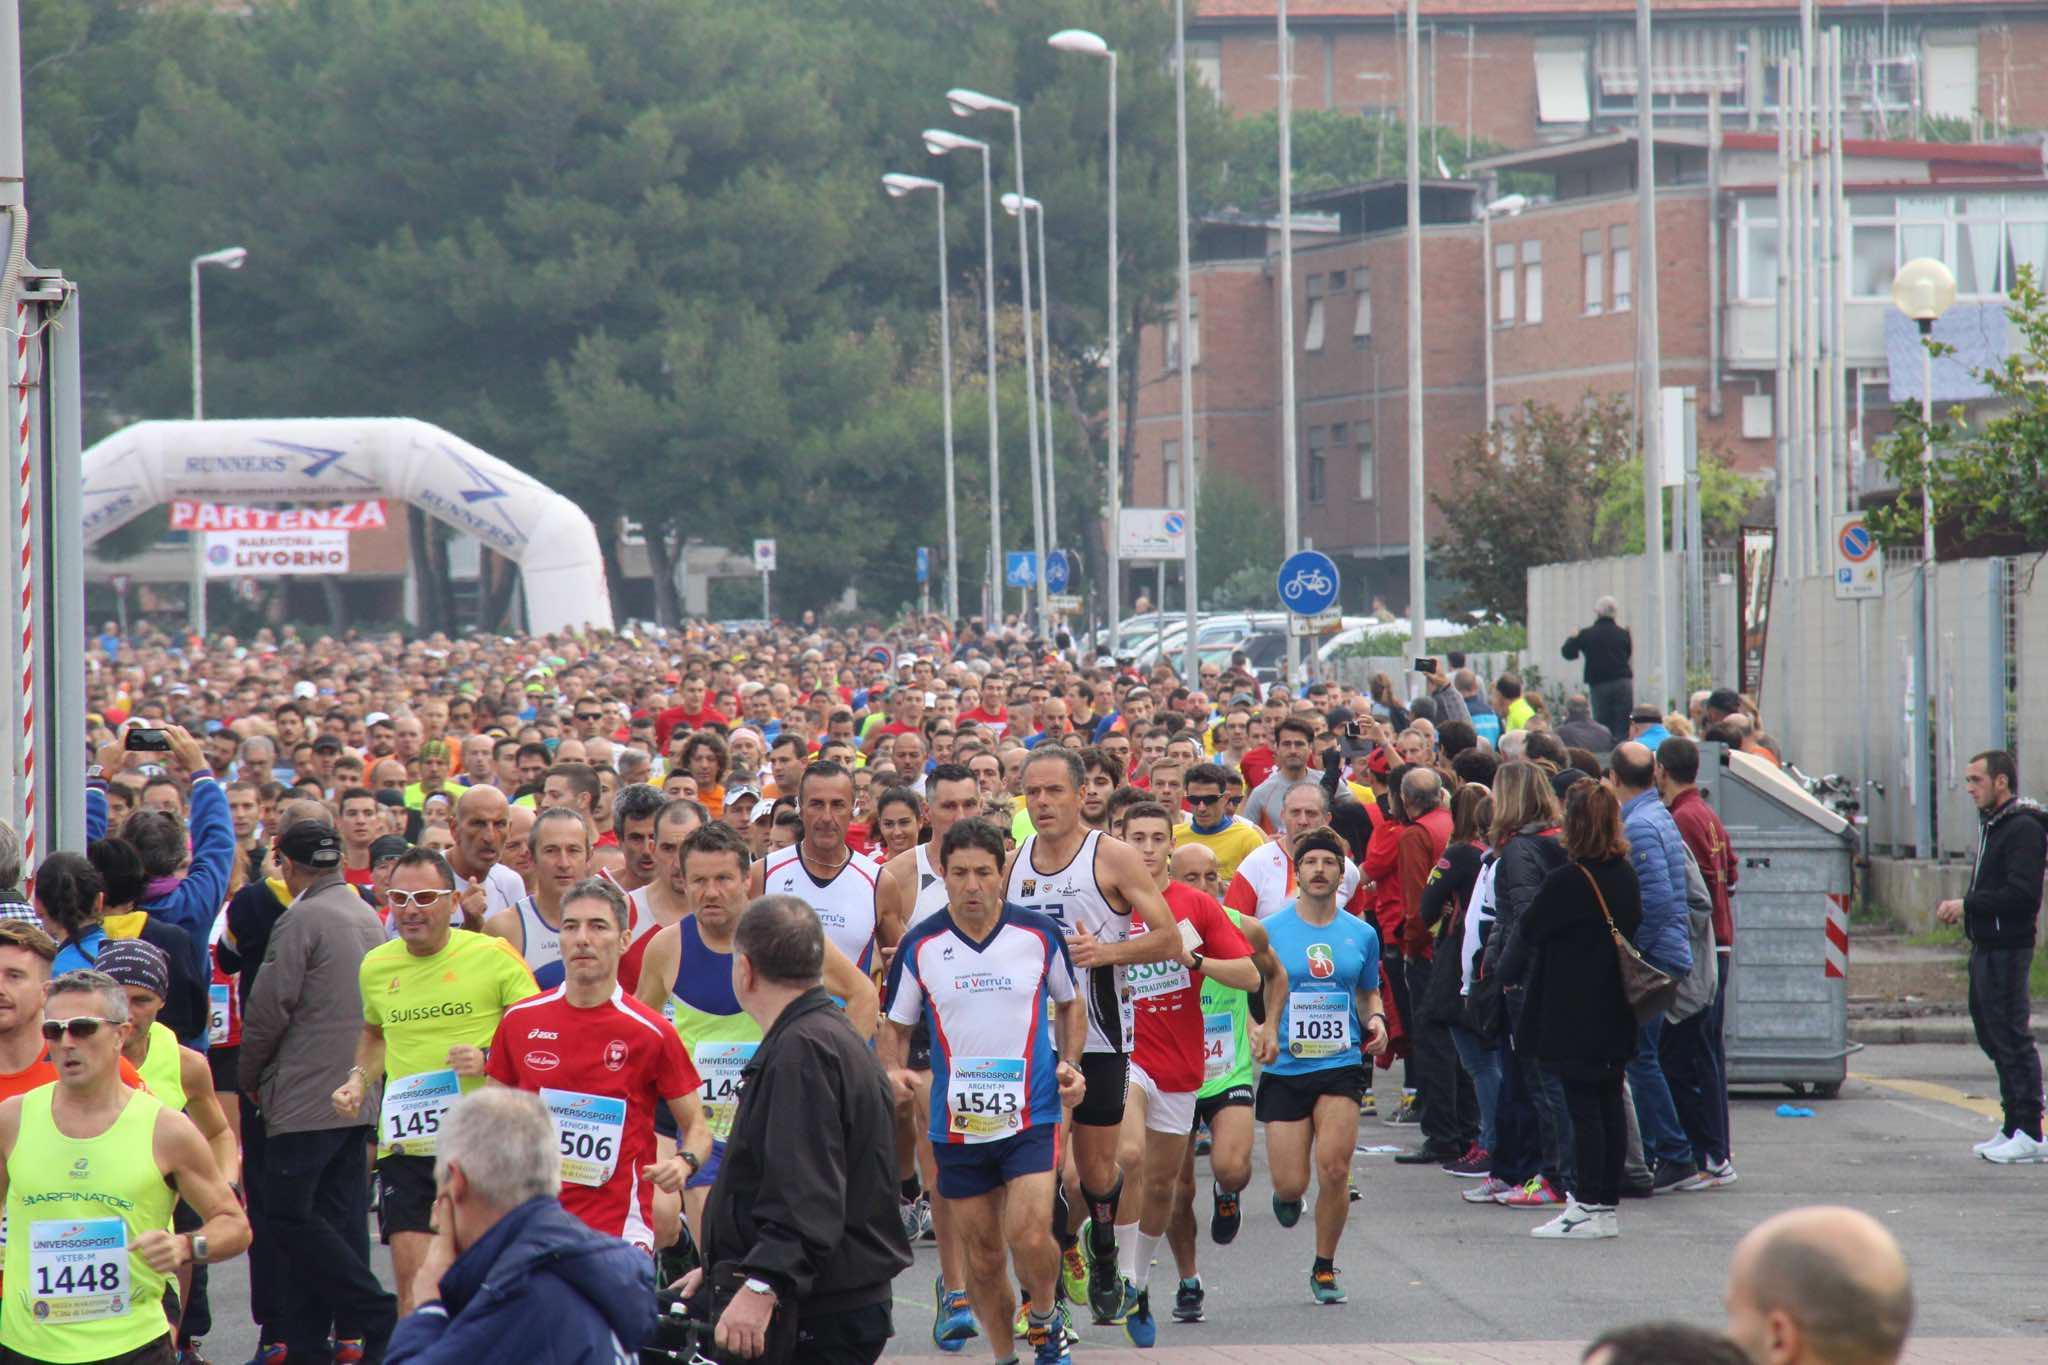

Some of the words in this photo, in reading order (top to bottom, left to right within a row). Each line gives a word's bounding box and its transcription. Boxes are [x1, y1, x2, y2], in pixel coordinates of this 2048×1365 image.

[184, 455, 287, 473] RUNNERS
[172, 500, 385, 529] PARTENZA
[235, 551, 343, 567] LIVORNO
[955, 980, 969, 989] La
[971, 976, 1012, 988] Verru'a
[1296, 1020, 1343, 1040] 1033
[955, 1071, 1021, 1080] UNIVERSOSPOR
[956, 1092, 1017, 1115] 1543
[548, 1106, 617, 1121] NIVERSOSPORT
[391, 1107, 449, 1139] 145
[560, 1130, 612, 1162] 506
[33, 1237, 117, 1250] UNIVERSOSPORT
[56, 1253, 96, 1263] VETER-M
[37, 1262, 120, 1295] 1448
